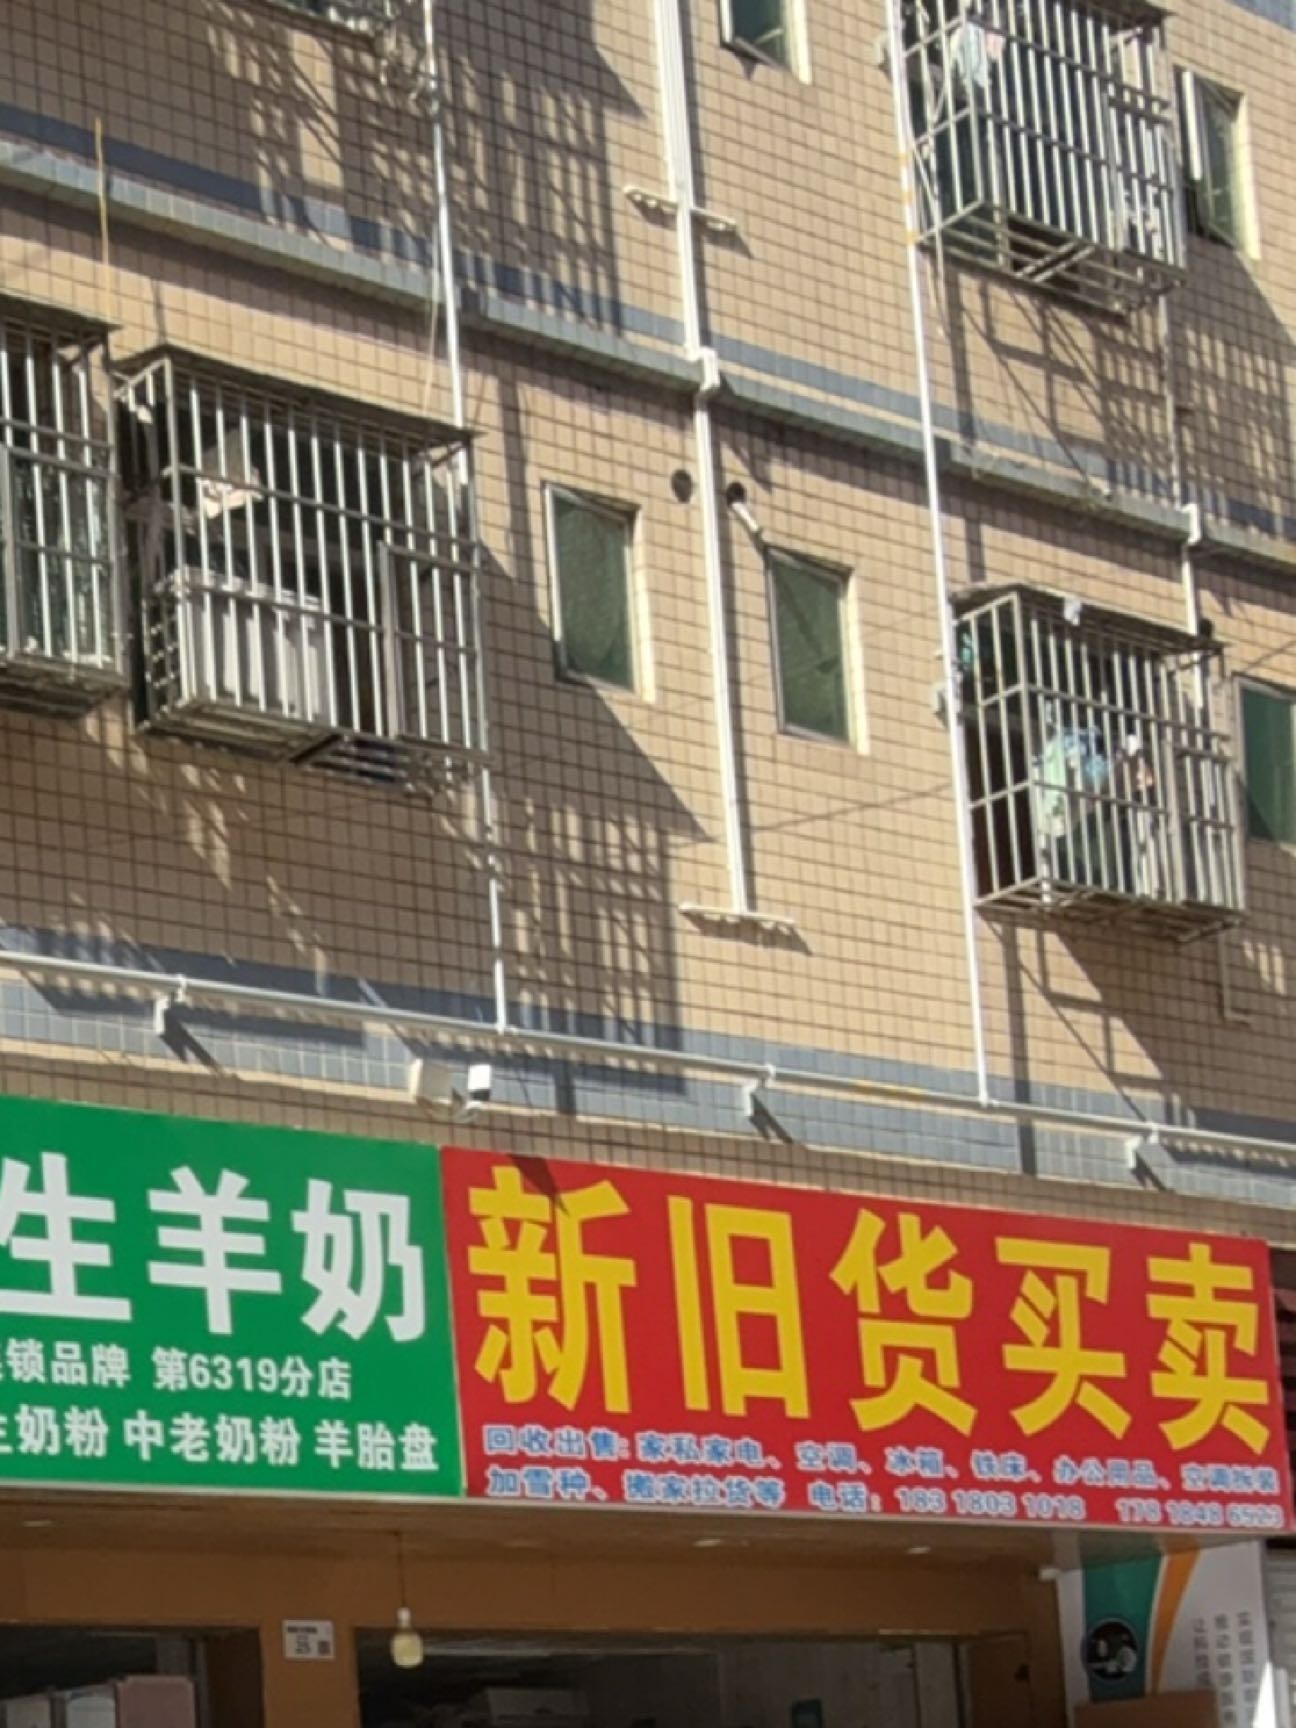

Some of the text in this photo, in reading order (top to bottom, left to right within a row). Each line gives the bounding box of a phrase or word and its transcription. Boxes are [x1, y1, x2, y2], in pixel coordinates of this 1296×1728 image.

[467, 1165, 1271, 1456] 新旧货买卖
[151, 1345, 354, 1400] 第6319分店
[122, 1408, 301, 1466] 中老奶粉
[313, 1418, 440, 1472] 羊胎盘
